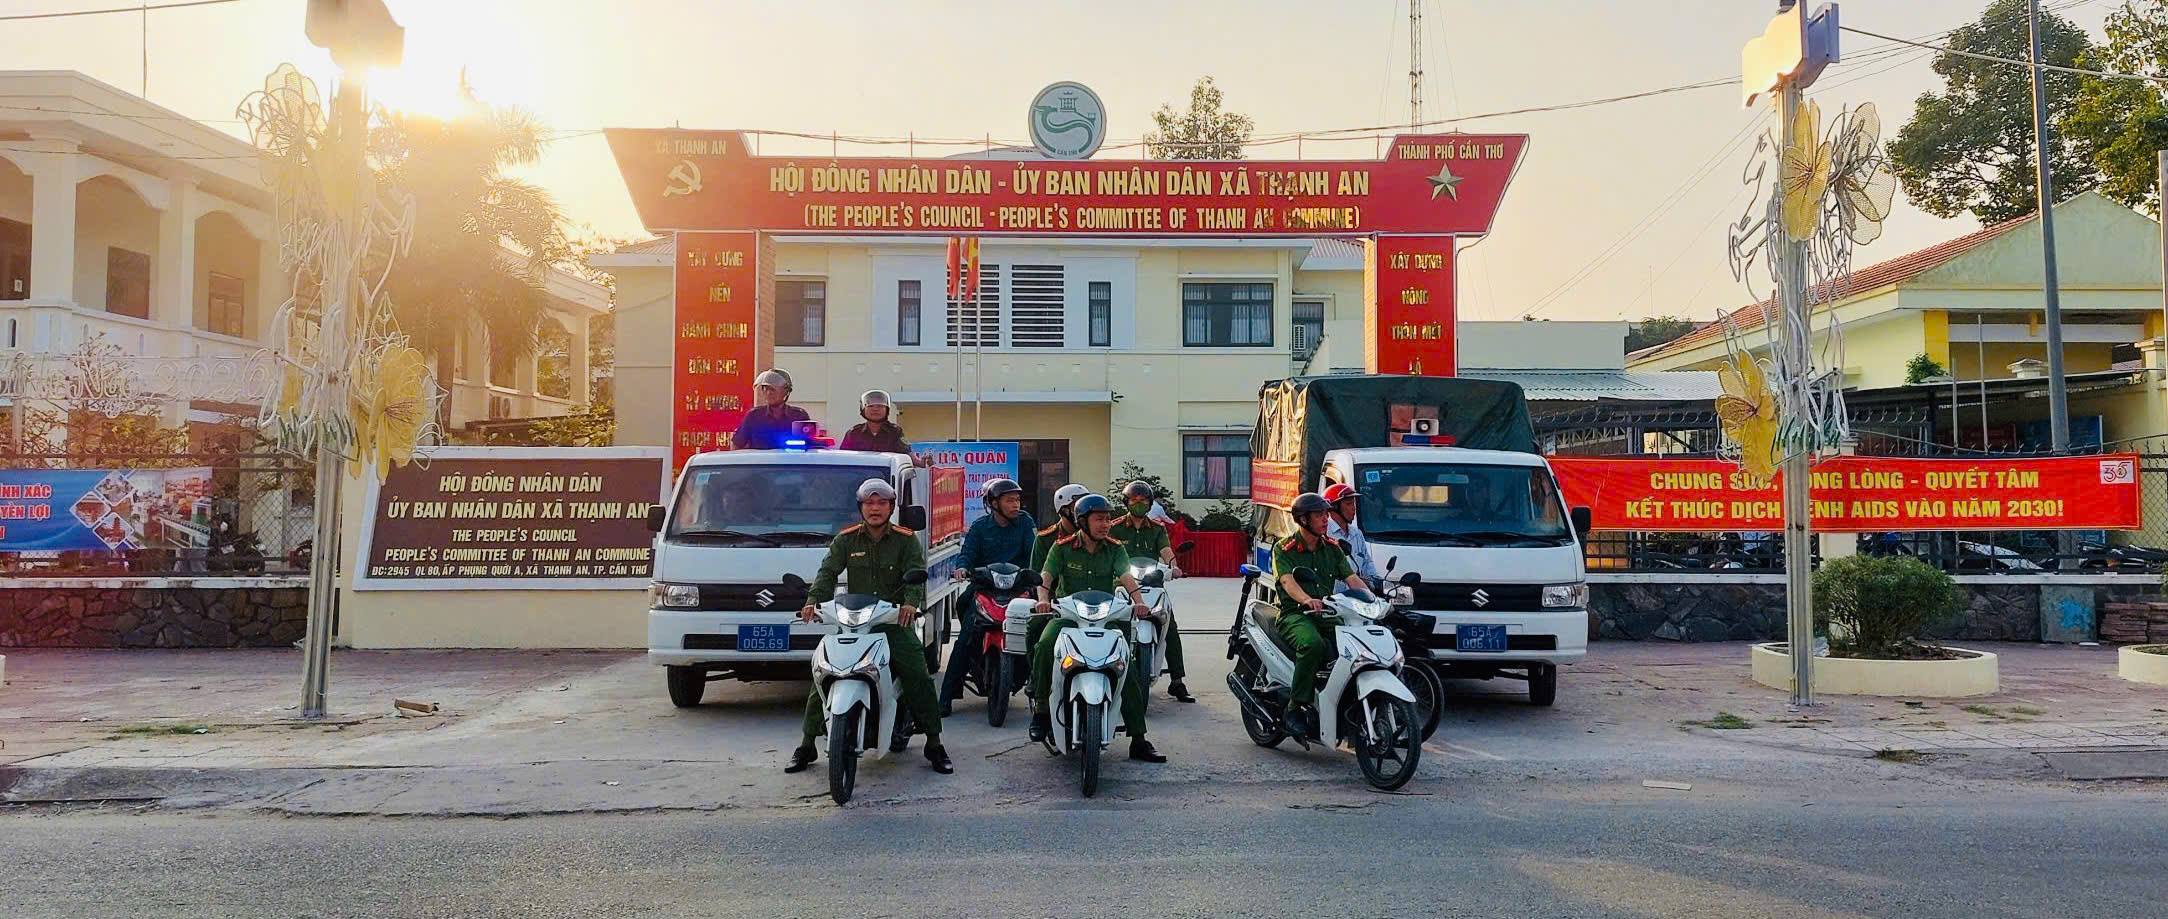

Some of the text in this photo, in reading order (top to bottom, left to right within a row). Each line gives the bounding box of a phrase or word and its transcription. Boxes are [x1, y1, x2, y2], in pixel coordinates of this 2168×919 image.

[675, 140, 707, 157] THẠNH
[712, 139, 727, 154] AN
[1398, 141, 1430, 159] THÀNH
[1435, 139, 1455, 159] PHỐ
[1485, 143, 1504, 159] THƠ
[770, 162, 804, 197] HỘI
[812, 159, 870, 192] ĐỒNG
[878, 164, 938, 193] NHÂN
[946, 165, 991, 194] DÂN
[1013, 161, 1041, 195] ỦY
[1046, 170, 1090, 195] BAN
[1097, 166, 1159, 196] NHÂN
[1167, 167, 1212, 196] DÂN
[1219, 167, 1250, 196] XÃ
[1256, 171, 1328, 200] THẠNH
[1337, 171, 1369, 195] AN
[804, 204, 837, 227] (THE
[844, 202, 913, 227] PEOPLE'S
[920, 206, 984, 228] COUNCIL
[1000, 203, 1068, 228] PEOPLE'S
[1076, 207, 1161, 229] COMMITTEE
[1169, 207, 1187, 229] OF
[1196, 207, 1246, 229] THANH
[1253, 207, 1274, 229] AN
[1282, 206, 1360, 230] COMMUNE)
[1390, 251, 1443, 272] XÂY DỰNG
[1402, 287, 1428, 305] NÔNG
[1392, 321, 1417, 340] THÔN
[964, 449, 1006, 465] QUÂN
[440, 470, 603, 496] HỘI ĐỒNG NHÂN DÂN
[1651, 472, 1722, 490] CHUNG
[1851, 468, 1904, 489] LÒNG
[1926, 466, 1989, 490] QUYẾT
[1995, 468, 2039, 489] TÂM
[23, 483, 52, 498] XÁC
[387, 495, 650, 523] ỦY BAN NHÂN DÂN XÃ THẠNH AN
[1626, 496, 1665, 518] KẾT
[1671, 498, 1724, 518] THÚC
[1731, 501, 1781, 522] DỊCH
[1851, 500, 1900, 518] AIDS
[1906, 497, 1946, 518] VÀO
[1952, 496, 2001, 517] NĂM
[2007, 499, 2064, 517] 2030!
[452, 527, 577, 541] THE PEOPLE'S COUNCIL
[385, 546, 650, 561] PEOPLE'S COMMITTEE OF THANH AN COMMUNE
[415, 566, 426, 577] QL
[458, 565, 488, 577] PHỤNG
[526, 564, 539, 575] XÃ
[543, 565, 572, 577] THẠNH
[593, 565, 607, 575] TP.
[631, 564, 648, 575] THƠ
[752, 626, 775, 638] 65A
[1471, 626, 1492, 638] 65A
[743, 638, 784, 650] 005.69
